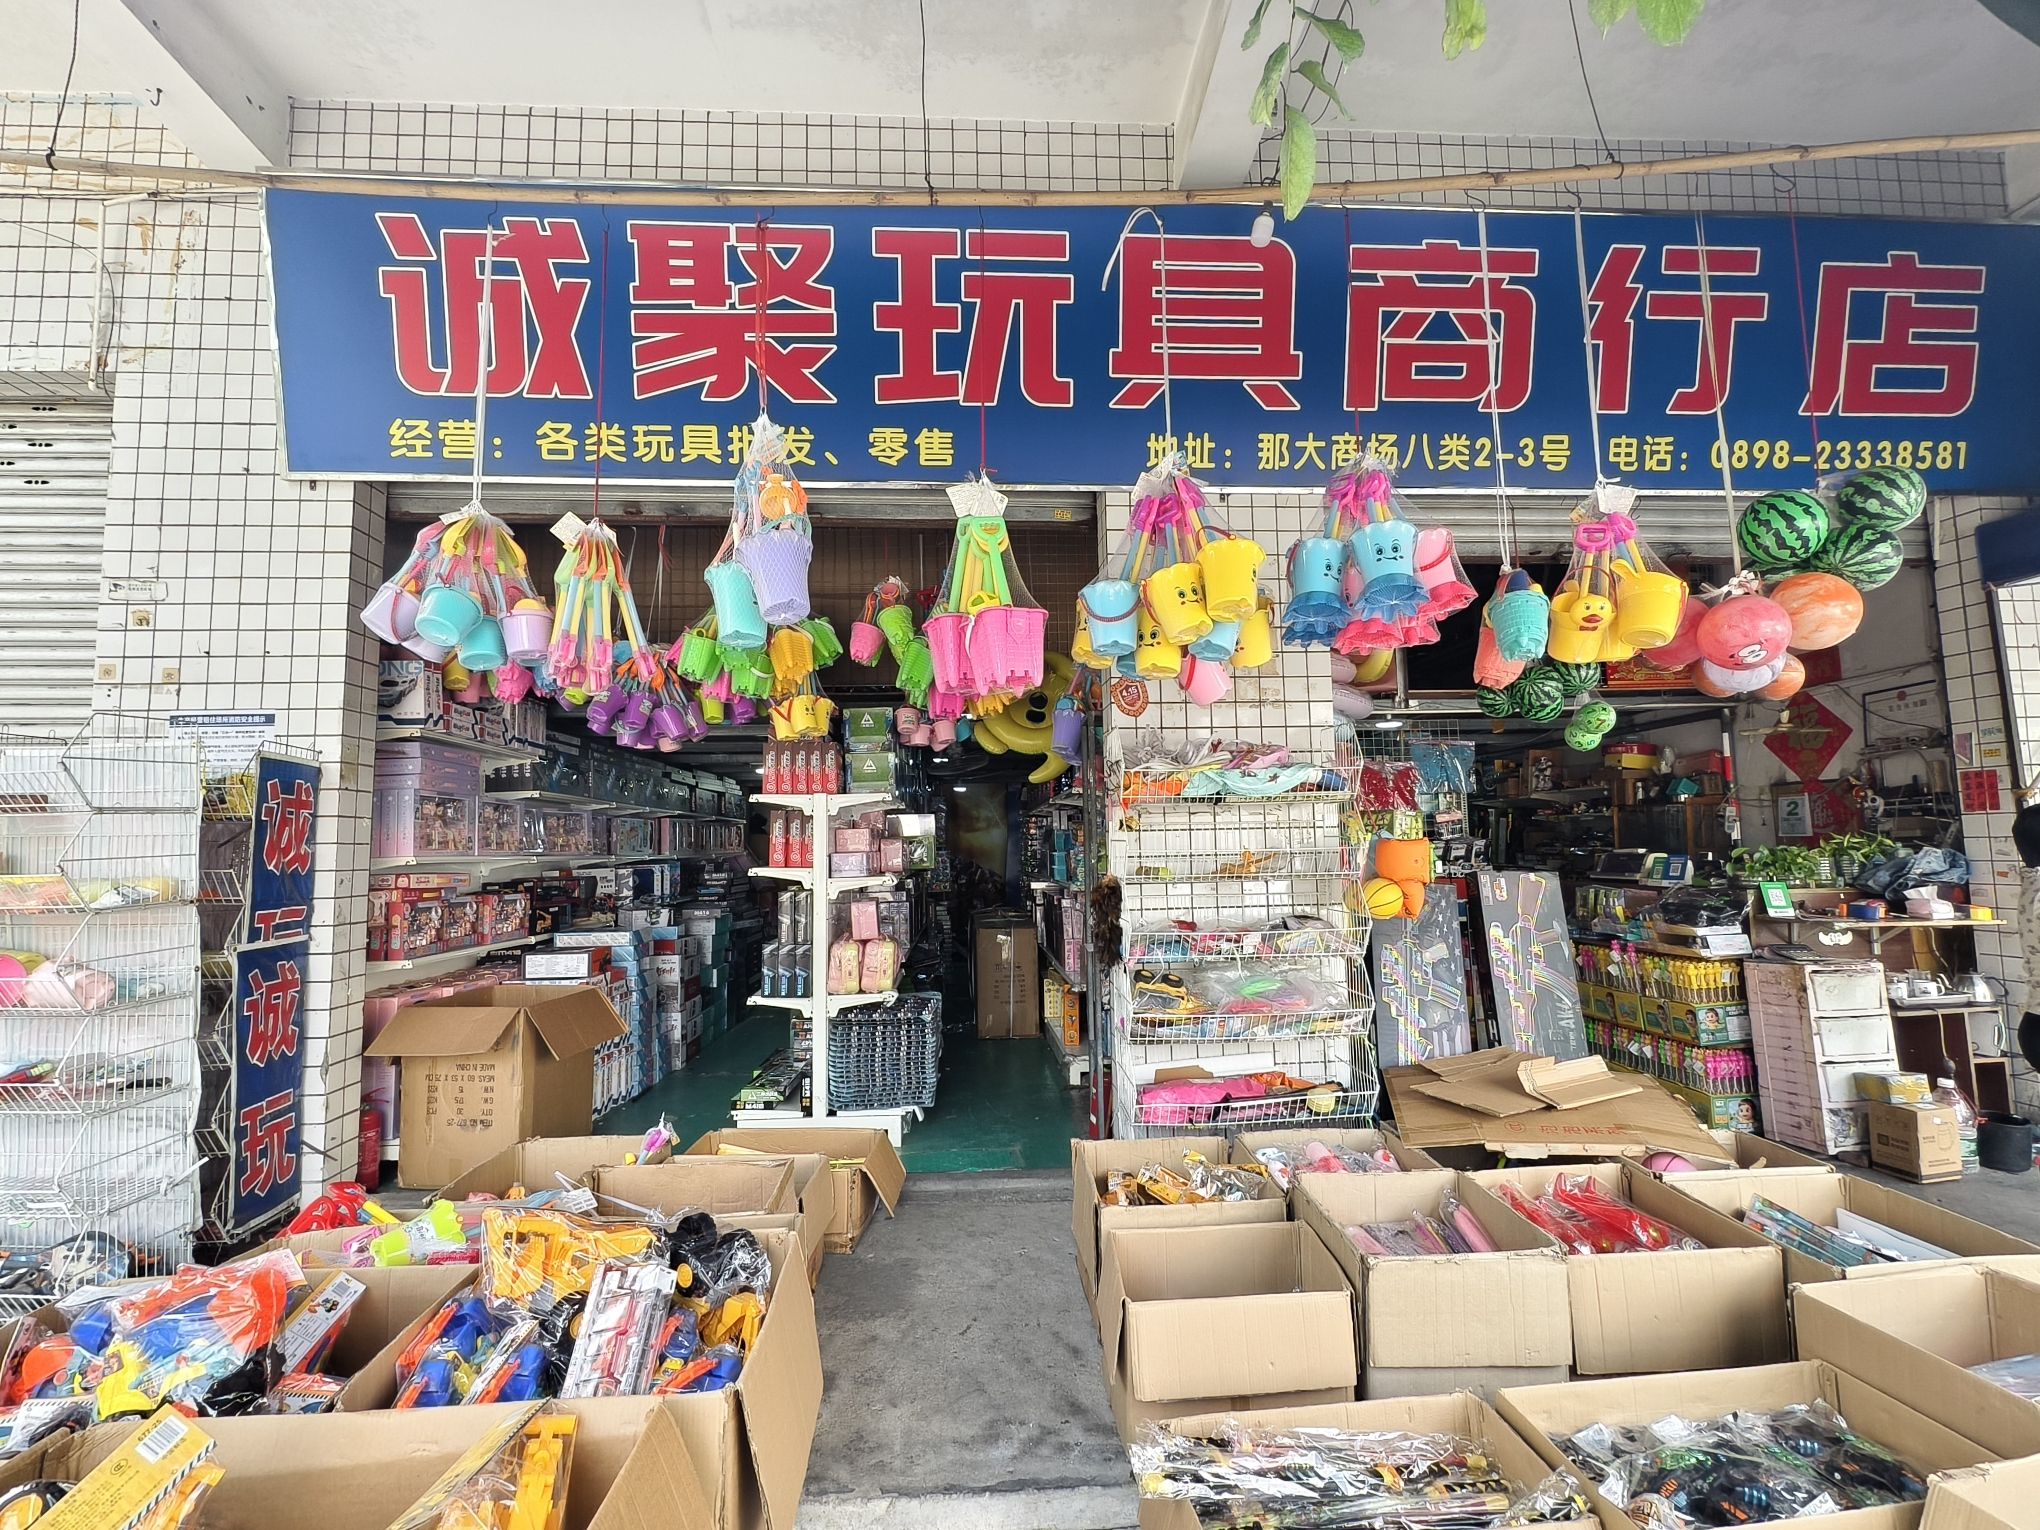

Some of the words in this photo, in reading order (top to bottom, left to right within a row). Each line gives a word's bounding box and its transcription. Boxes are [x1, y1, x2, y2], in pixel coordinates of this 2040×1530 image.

[375, 211, 1987, 418] 诚聚玩具商行店
[1786, 800, 1799, 817] 2
[456, 1063, 472, 1072] CHINA
[479, 1063, 495, 1072] MADE
[240, 961, 301, 1198] 诚玩
